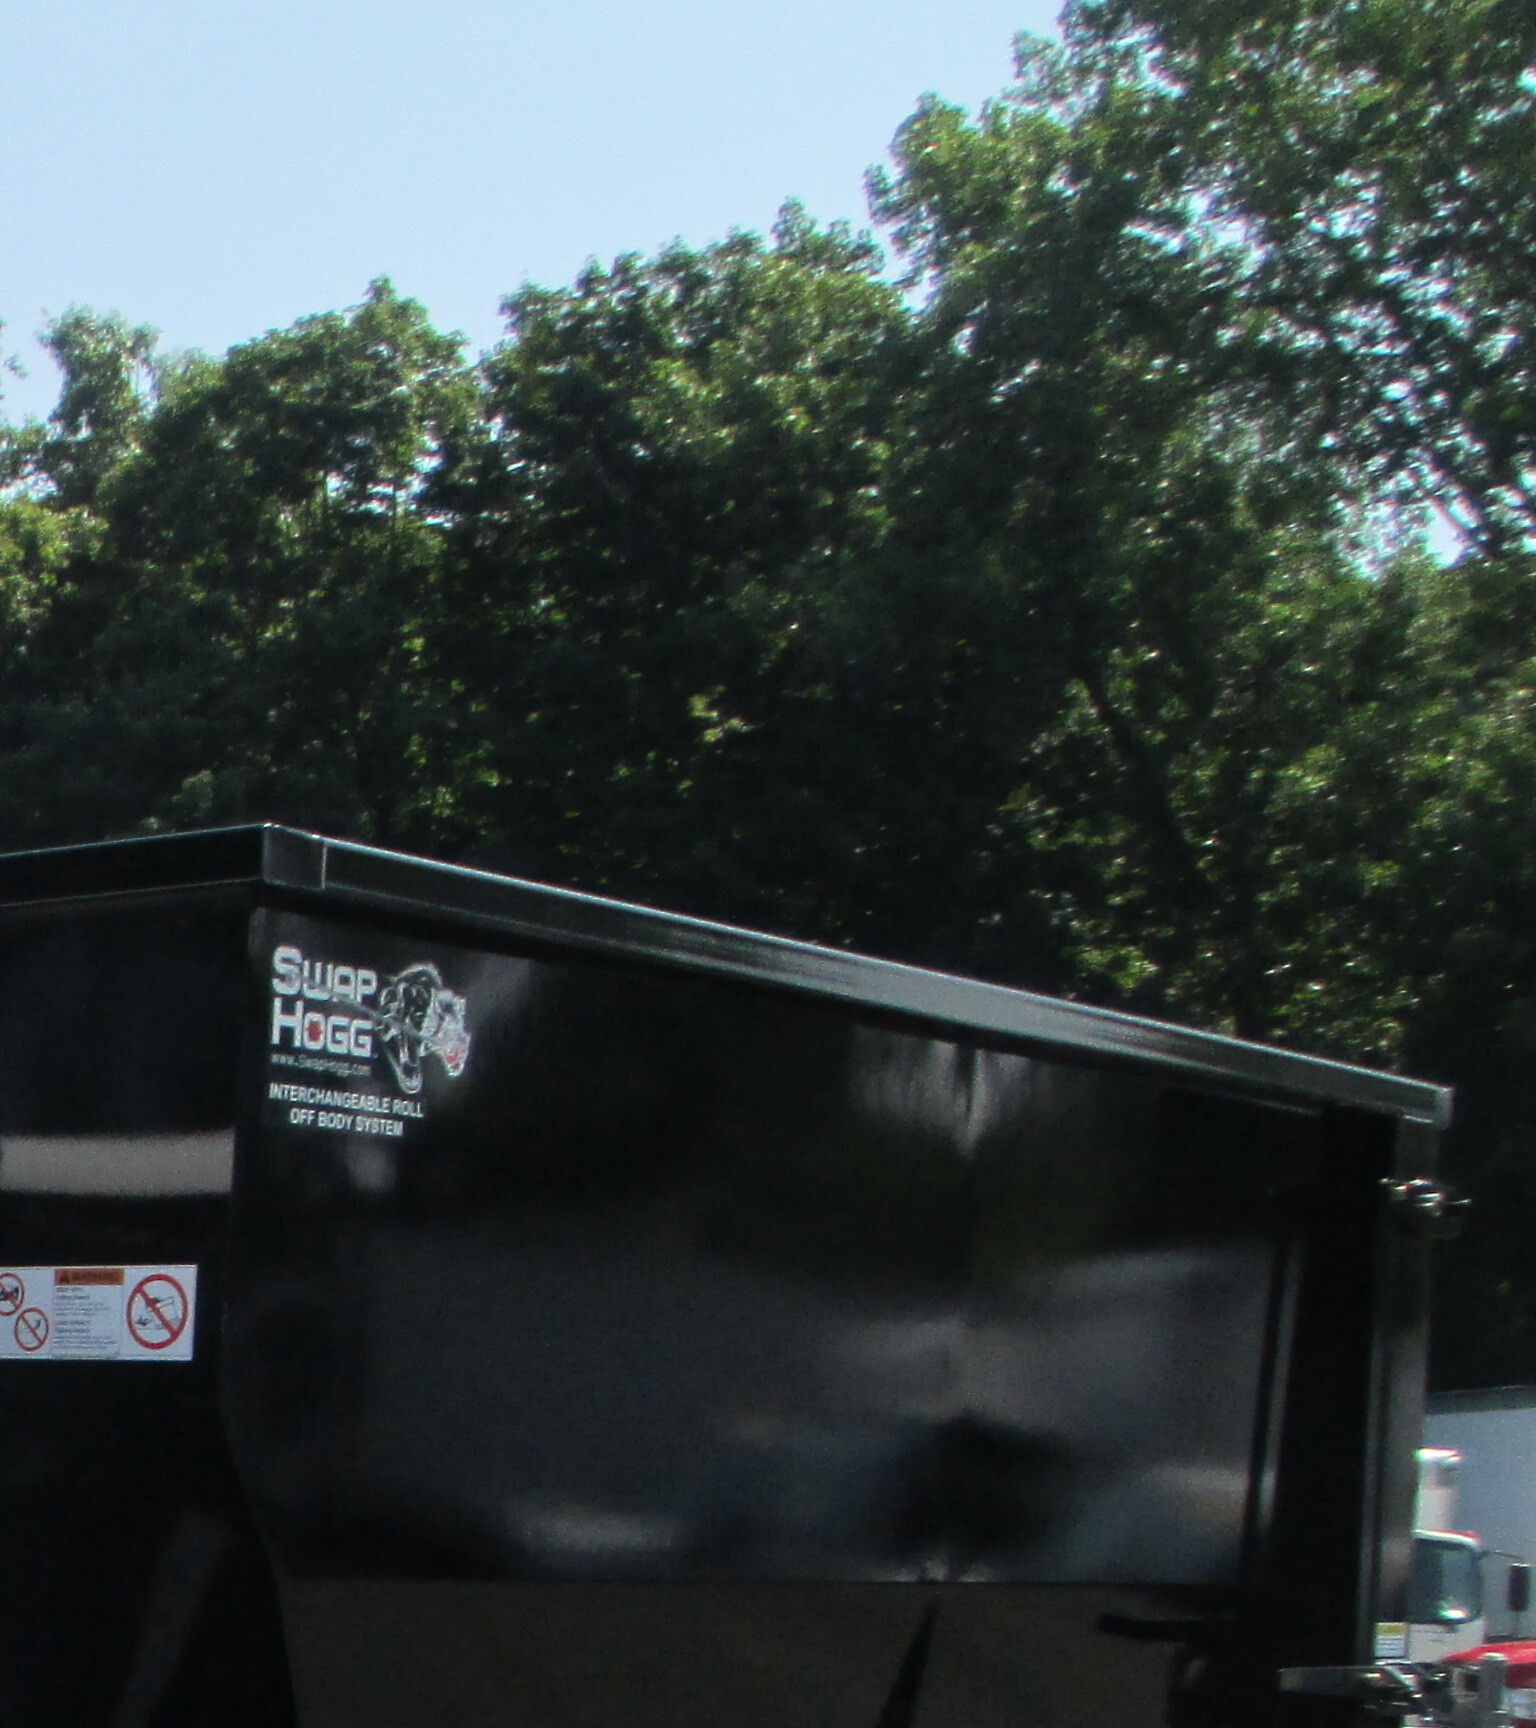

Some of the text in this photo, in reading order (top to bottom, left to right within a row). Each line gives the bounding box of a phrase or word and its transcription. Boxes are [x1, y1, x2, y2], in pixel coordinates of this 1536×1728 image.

[268, 1082, 424, 1118] INTERCHANGEABLE ROLL
[289, 1107, 404, 1136] OFF BODY SYSTEM
